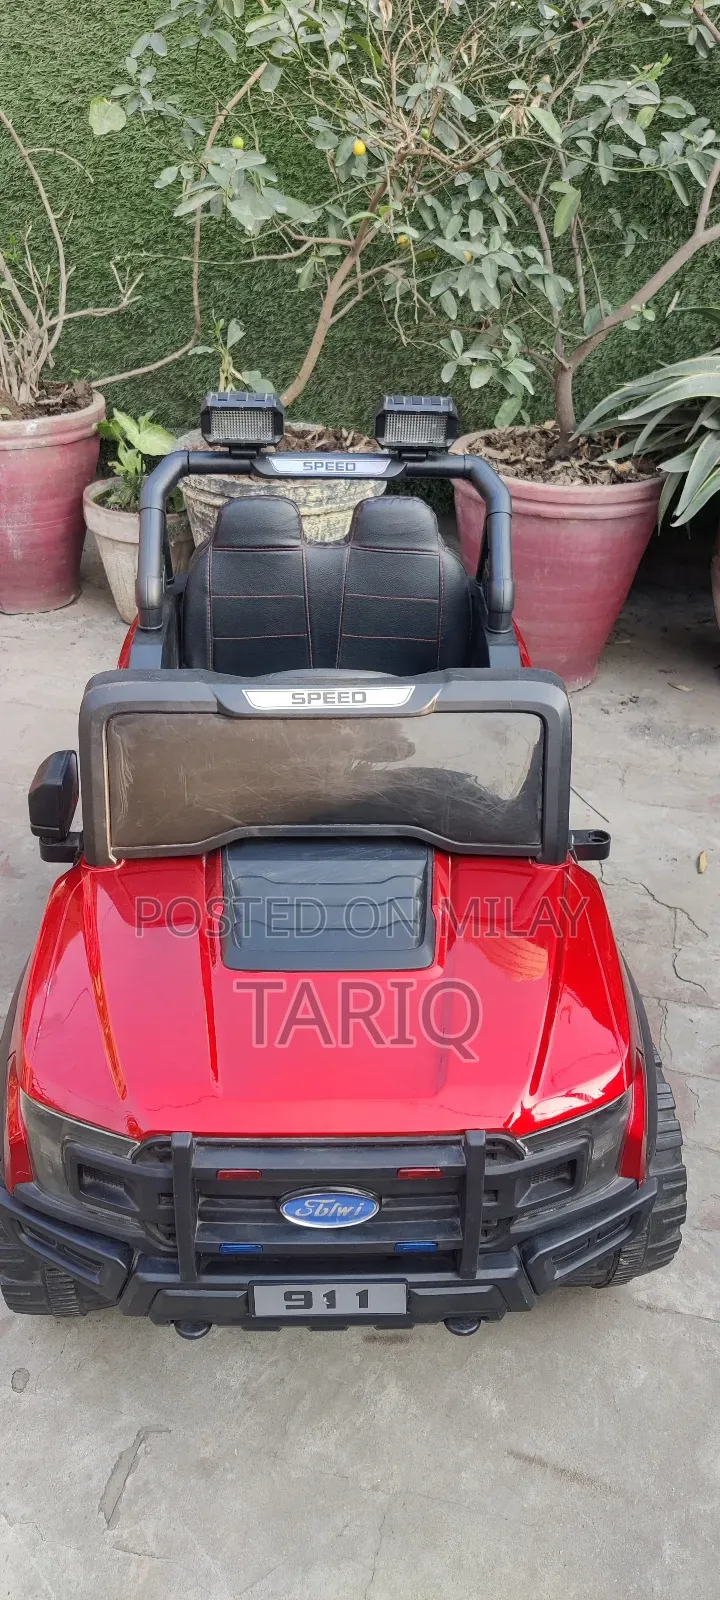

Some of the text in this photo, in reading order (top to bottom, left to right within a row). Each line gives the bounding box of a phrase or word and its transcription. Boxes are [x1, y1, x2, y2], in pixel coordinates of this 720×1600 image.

[303, 461, 356, 471] SPEED
[291, 691, 367, 705] SPEED
[283, 1289, 369, 1310] 911
